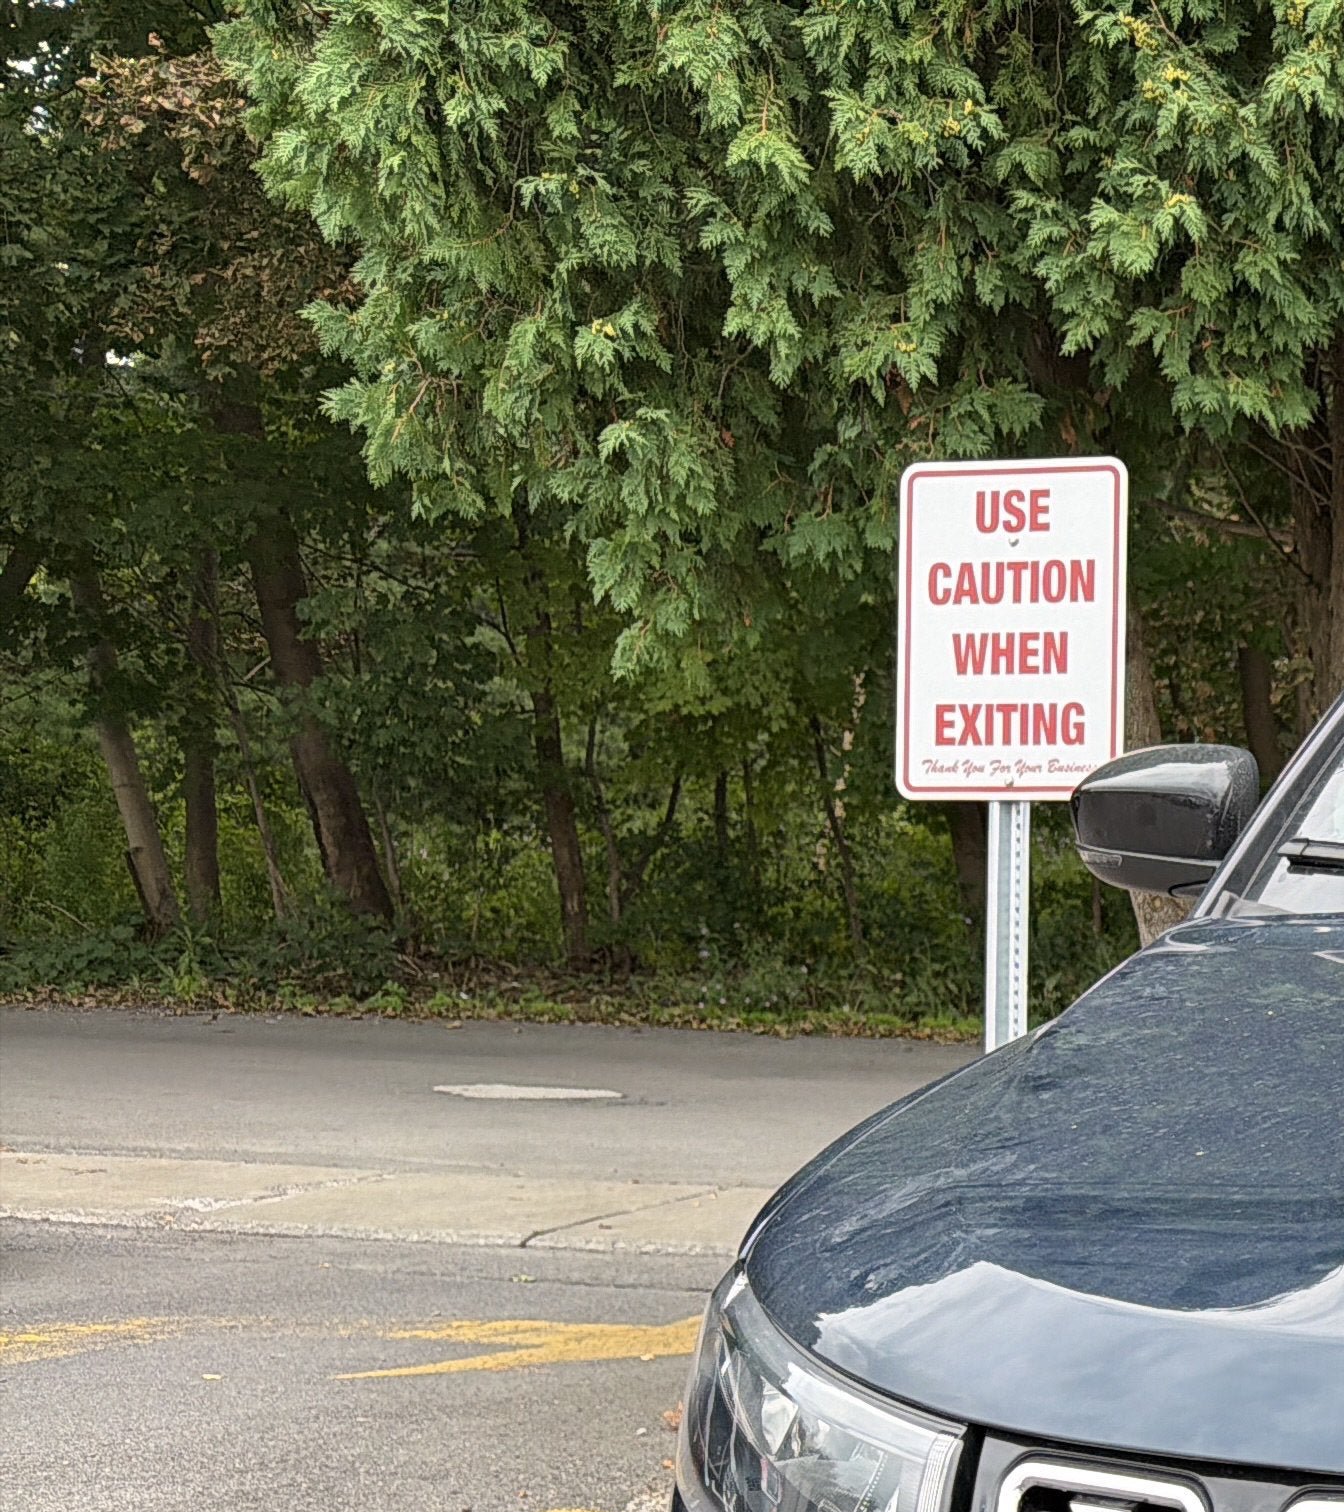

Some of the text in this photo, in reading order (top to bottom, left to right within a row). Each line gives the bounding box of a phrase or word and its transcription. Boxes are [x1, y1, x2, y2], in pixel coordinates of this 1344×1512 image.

[976, 489, 1051, 534] USE
[928, 559, 1096, 606] CAUTION
[952, 631, 1069, 676] WHEN
[934, 702, 1086, 747] EXITING
[921, 759, 959, 774] Thank
[961, 759, 985, 778] You
[989, 758, 1011, 777] For
[1014, 759, 1042, 778] Your
